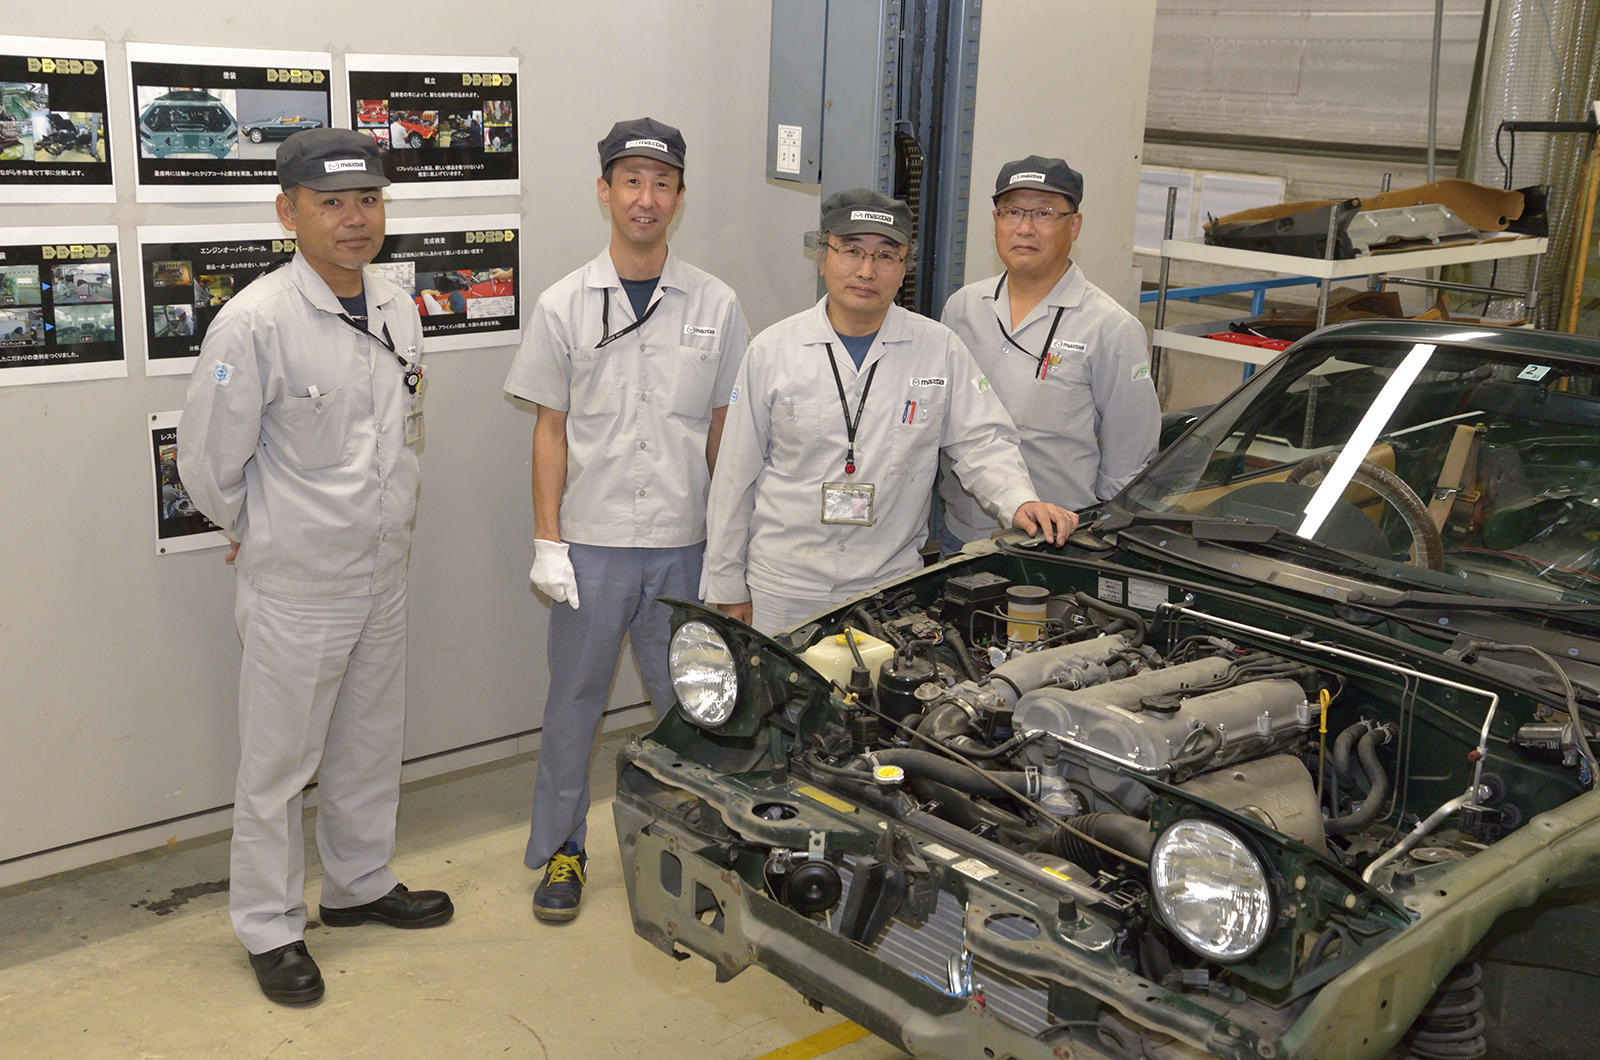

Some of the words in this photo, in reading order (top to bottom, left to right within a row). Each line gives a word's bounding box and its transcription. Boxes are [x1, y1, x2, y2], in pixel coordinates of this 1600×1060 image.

[223, 71, 237, 80] 塗装
[424, 77, 437, 85] 組立
[638, 140, 665, 149] mazda
[864, 213, 892, 222] mazda
[423, 237, 446, 245] 完成検査
[200, 245, 267, 254] エンジンオーバーホール
[422, 321, 501, 331] 品検査、アライメント調整、水漏れ検査を実施。
[1062, 342, 1085, 351] mazda
[0, 351, 80, 362] たこだわりの塗料をつくりました。
[1525, 365, 1538, 375] 2
[921, 378, 945, 386] mazda
